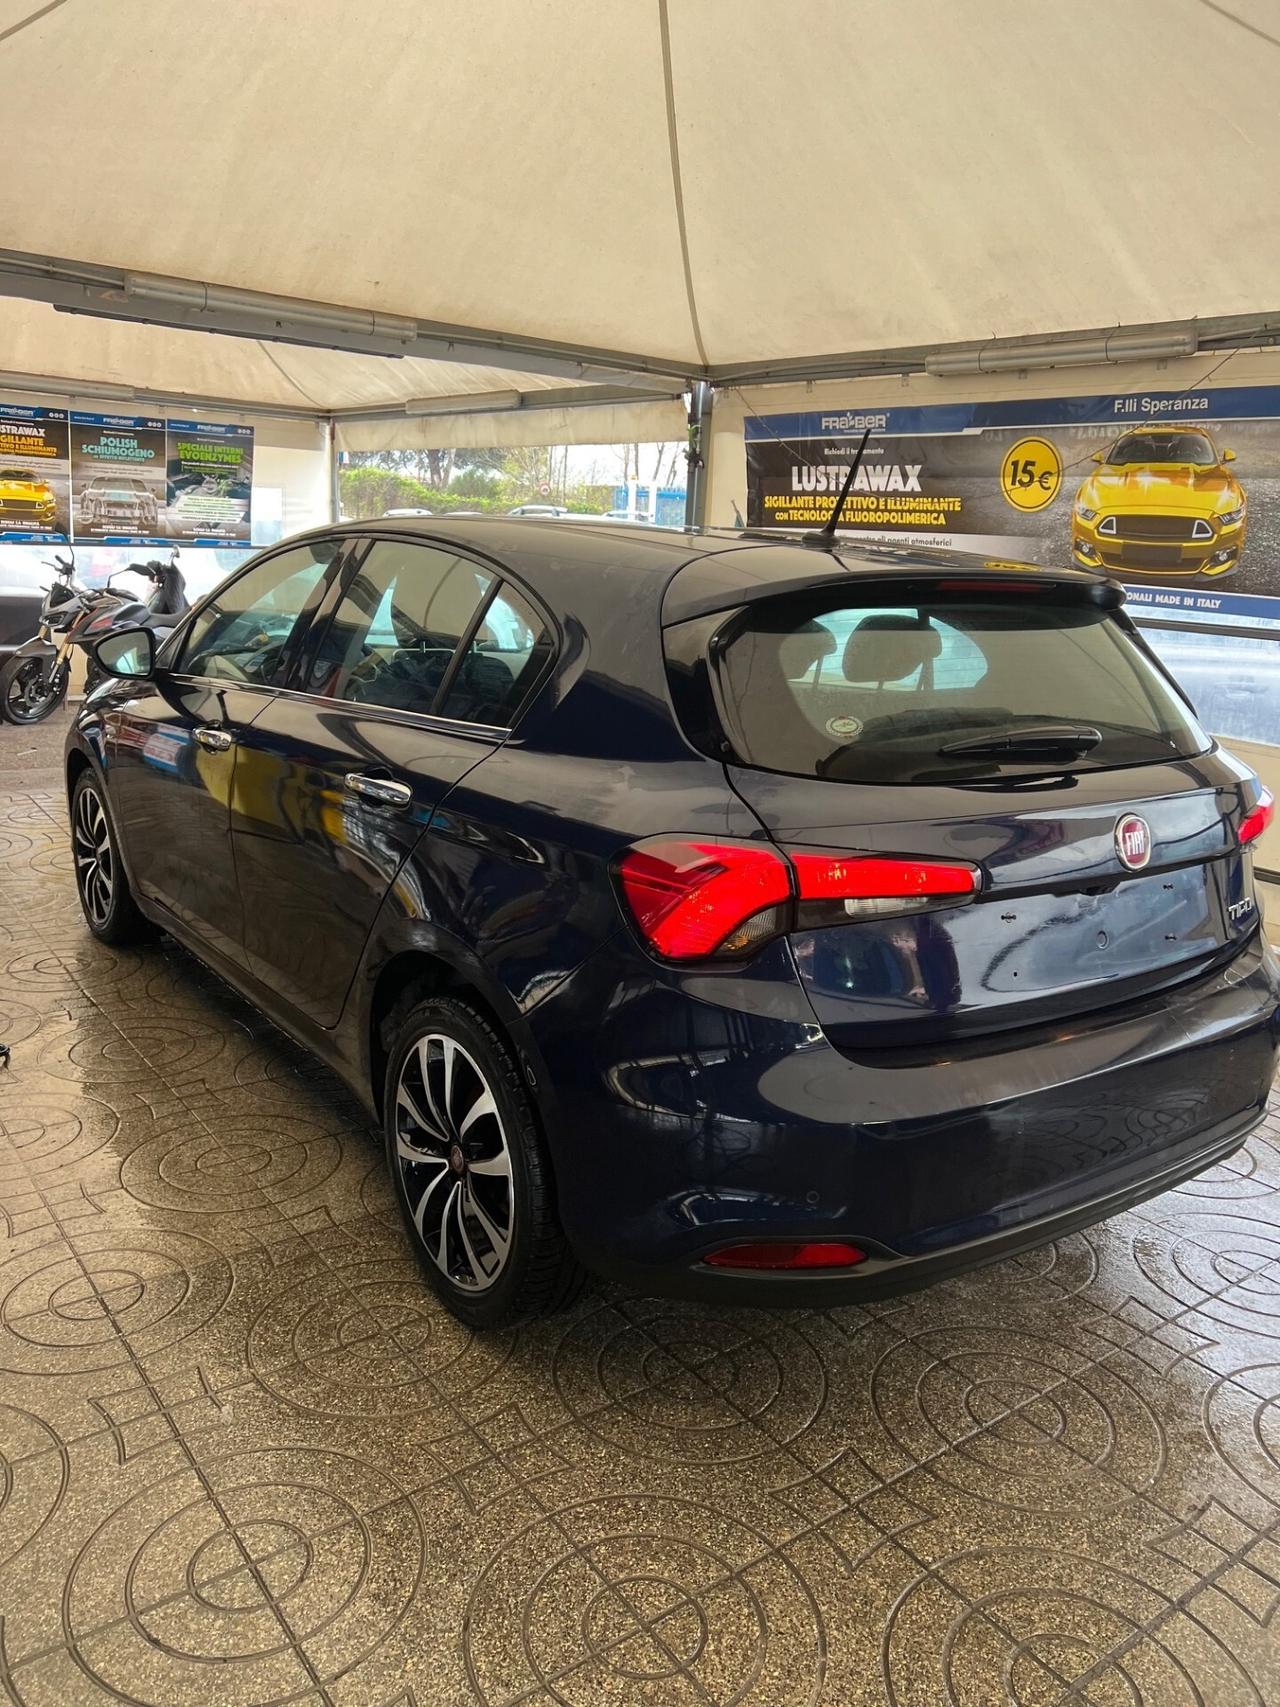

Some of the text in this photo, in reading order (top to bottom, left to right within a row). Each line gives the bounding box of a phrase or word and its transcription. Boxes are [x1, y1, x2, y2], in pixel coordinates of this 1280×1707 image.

[1141, 397, 1209, 414] Speranza
[0, 425, 46, 437] STRAWAX
[0, 434, 44, 446] GILLANTE
[100, 436, 138, 449] POLISH
[82, 444, 155, 459] SCHIUMOGENO
[180, 450, 242, 463] EVOENZYMES
[851, 447, 884, 456] tramento
[791, 465, 922, 492] LUSTRAWAX
[764, 495, 814, 508] SIGILLANTE
[879, 497, 886, 510] E
[887, 496, 962, 511] ILLUMINANTE
[789, 509, 845, 522] TECNOLOGA
[846, 511, 946, 525] FLUOROPOLIMERICA
[911, 537, 952, 547] atmosferici
[1126, 591, 1222, 609] ONALI MADE IN ITALY
[1125, 830, 1145, 857] FIAT
[1228, 897, 1252, 921] TIPO
